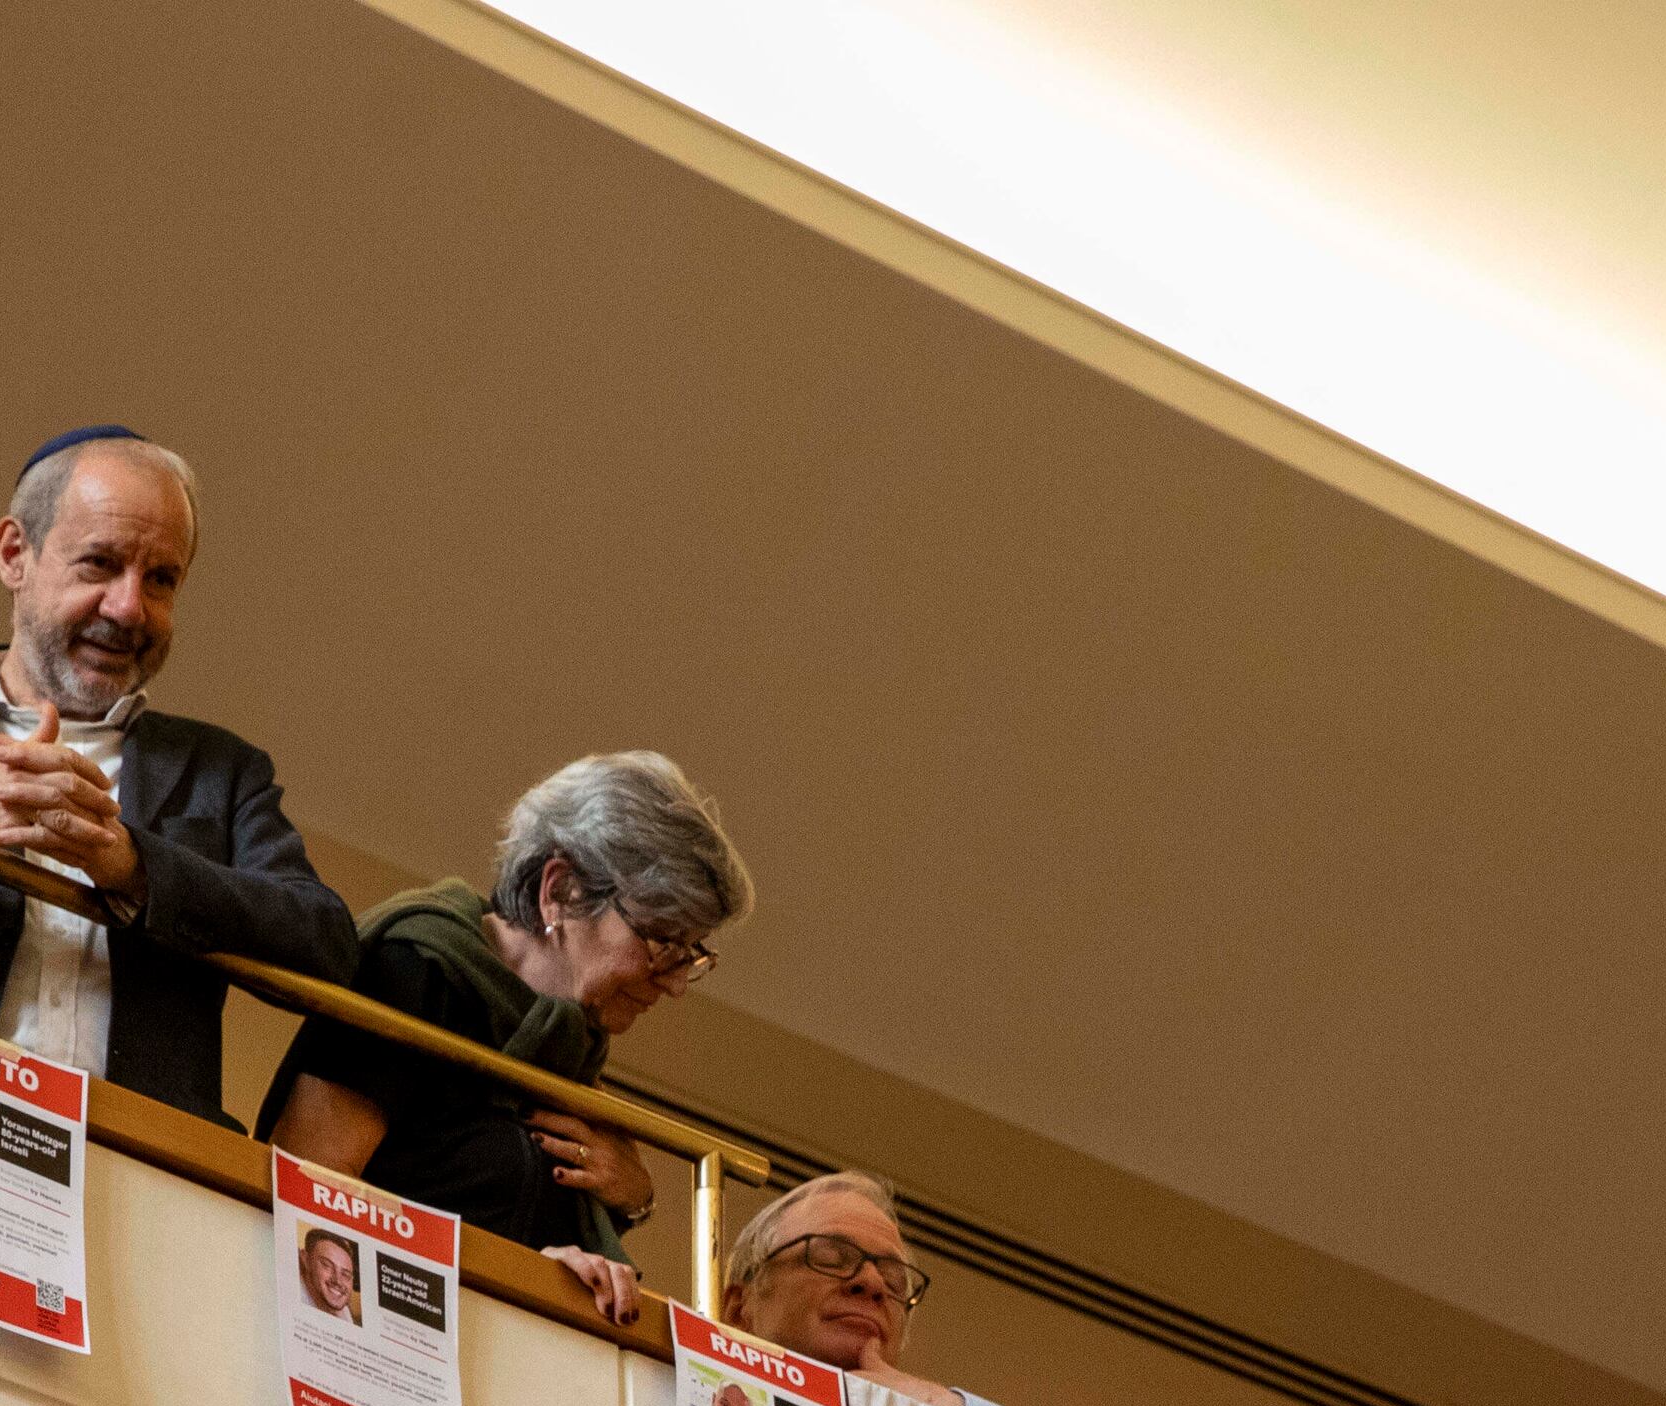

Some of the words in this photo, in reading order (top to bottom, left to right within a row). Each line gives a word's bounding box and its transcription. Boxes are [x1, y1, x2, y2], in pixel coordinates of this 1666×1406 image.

[0, 1138, 28, 1157] Israeli
[1, 1115, 29, 1135] Yoram
[31, 1128, 67, 1153] Metzger
[313, 1183, 414, 1239] RAPITO
[381, 1283, 441, 1315] Israeli-American
[710, 1333, 805, 1387] RAPITO
